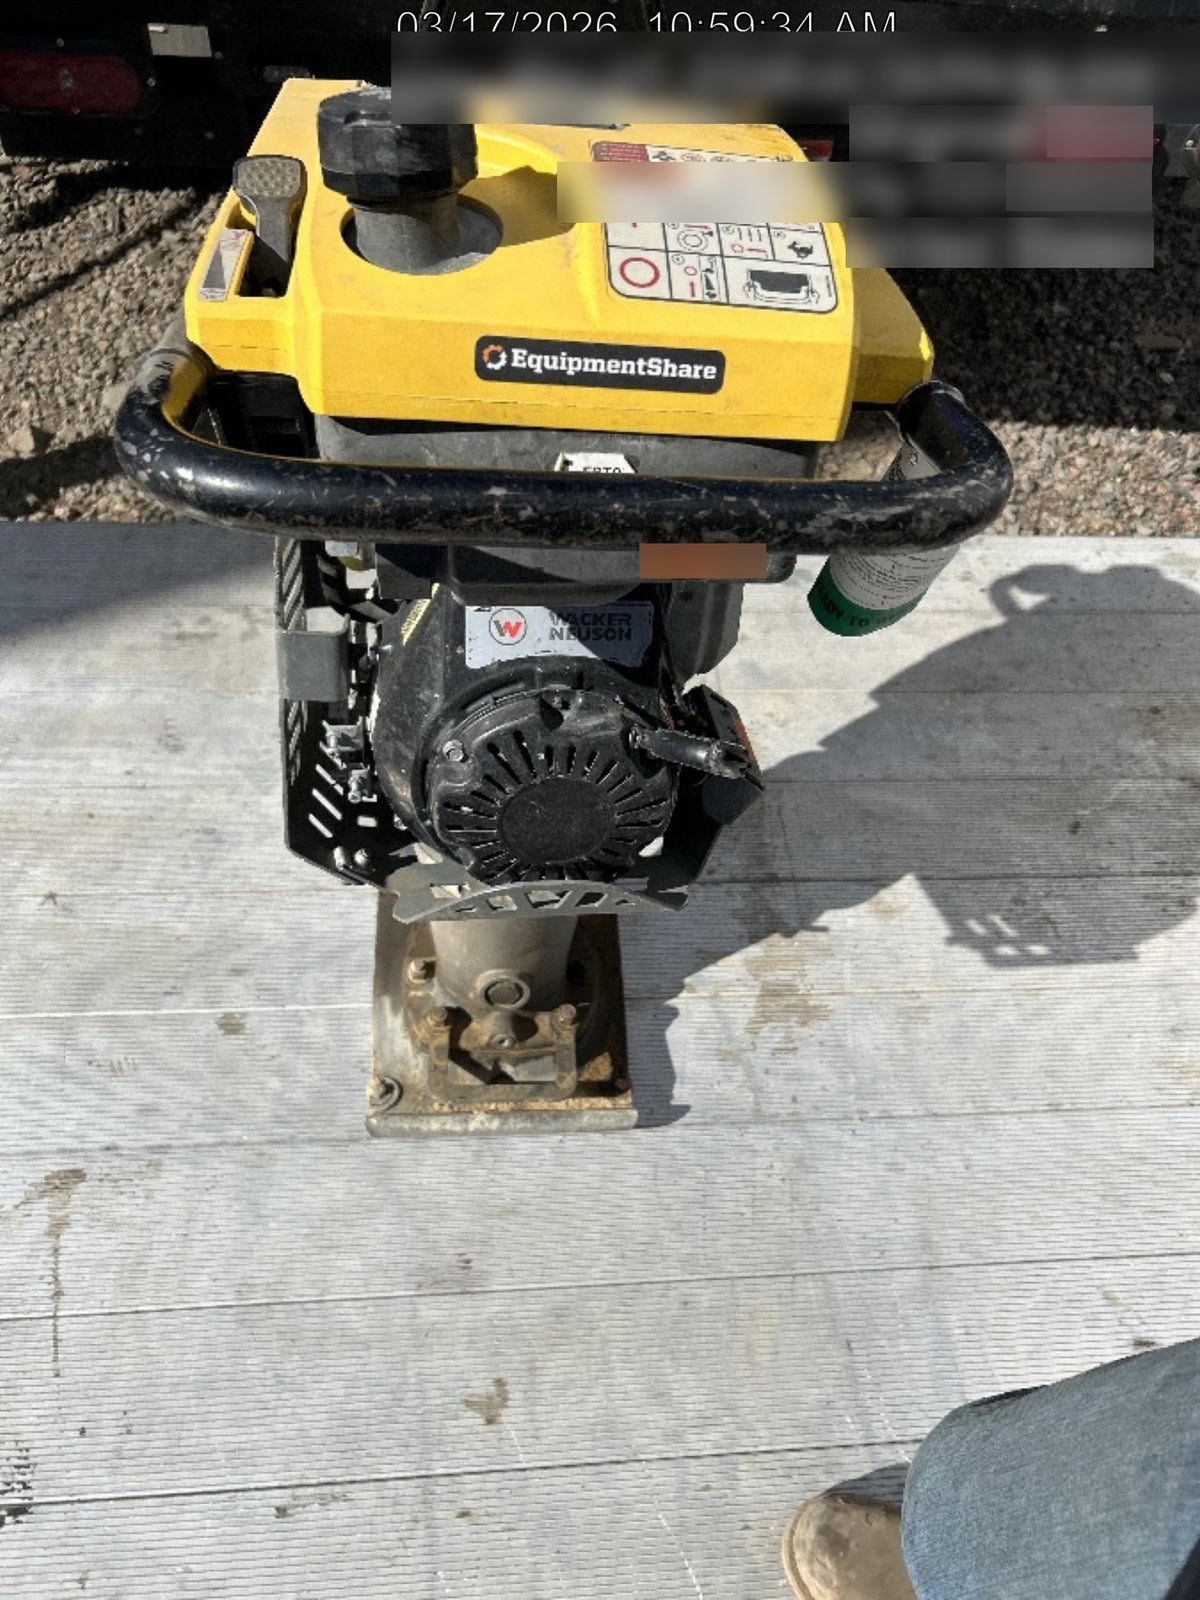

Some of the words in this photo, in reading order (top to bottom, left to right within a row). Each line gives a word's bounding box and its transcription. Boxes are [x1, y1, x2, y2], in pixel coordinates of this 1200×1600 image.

[511, 348, 717, 380] EquipmentShare
[549, 611, 632, 627] WACKER
[549, 627, 633, 642] NEUSON
